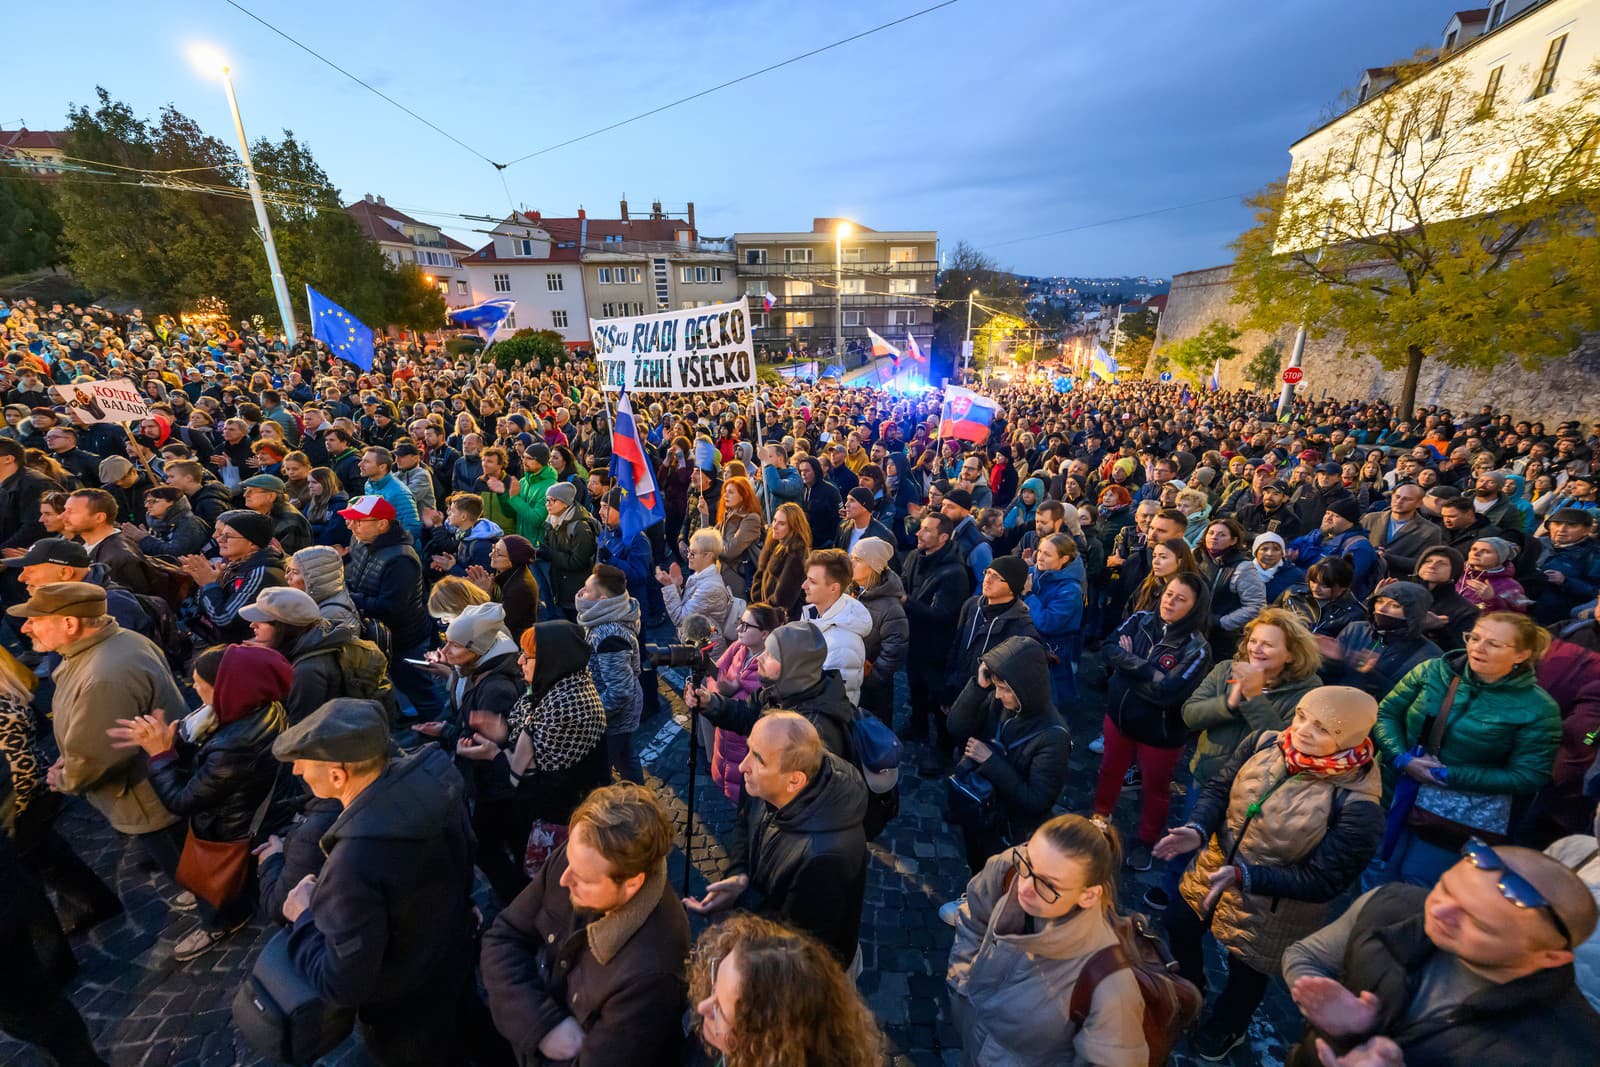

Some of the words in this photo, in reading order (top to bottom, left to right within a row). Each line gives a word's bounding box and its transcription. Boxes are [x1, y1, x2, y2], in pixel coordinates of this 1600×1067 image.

[632, 319, 679, 353] RIADI
[684, 308, 745, 351] DECKO
[633, 353, 672, 388] ŽEHLÍ
[678, 350, 750, 388] VŠECKO
[1284, 372, 1302, 380] STOP
[93, 385, 142, 404] KONIEC
[101, 398, 150, 416] BALADY
